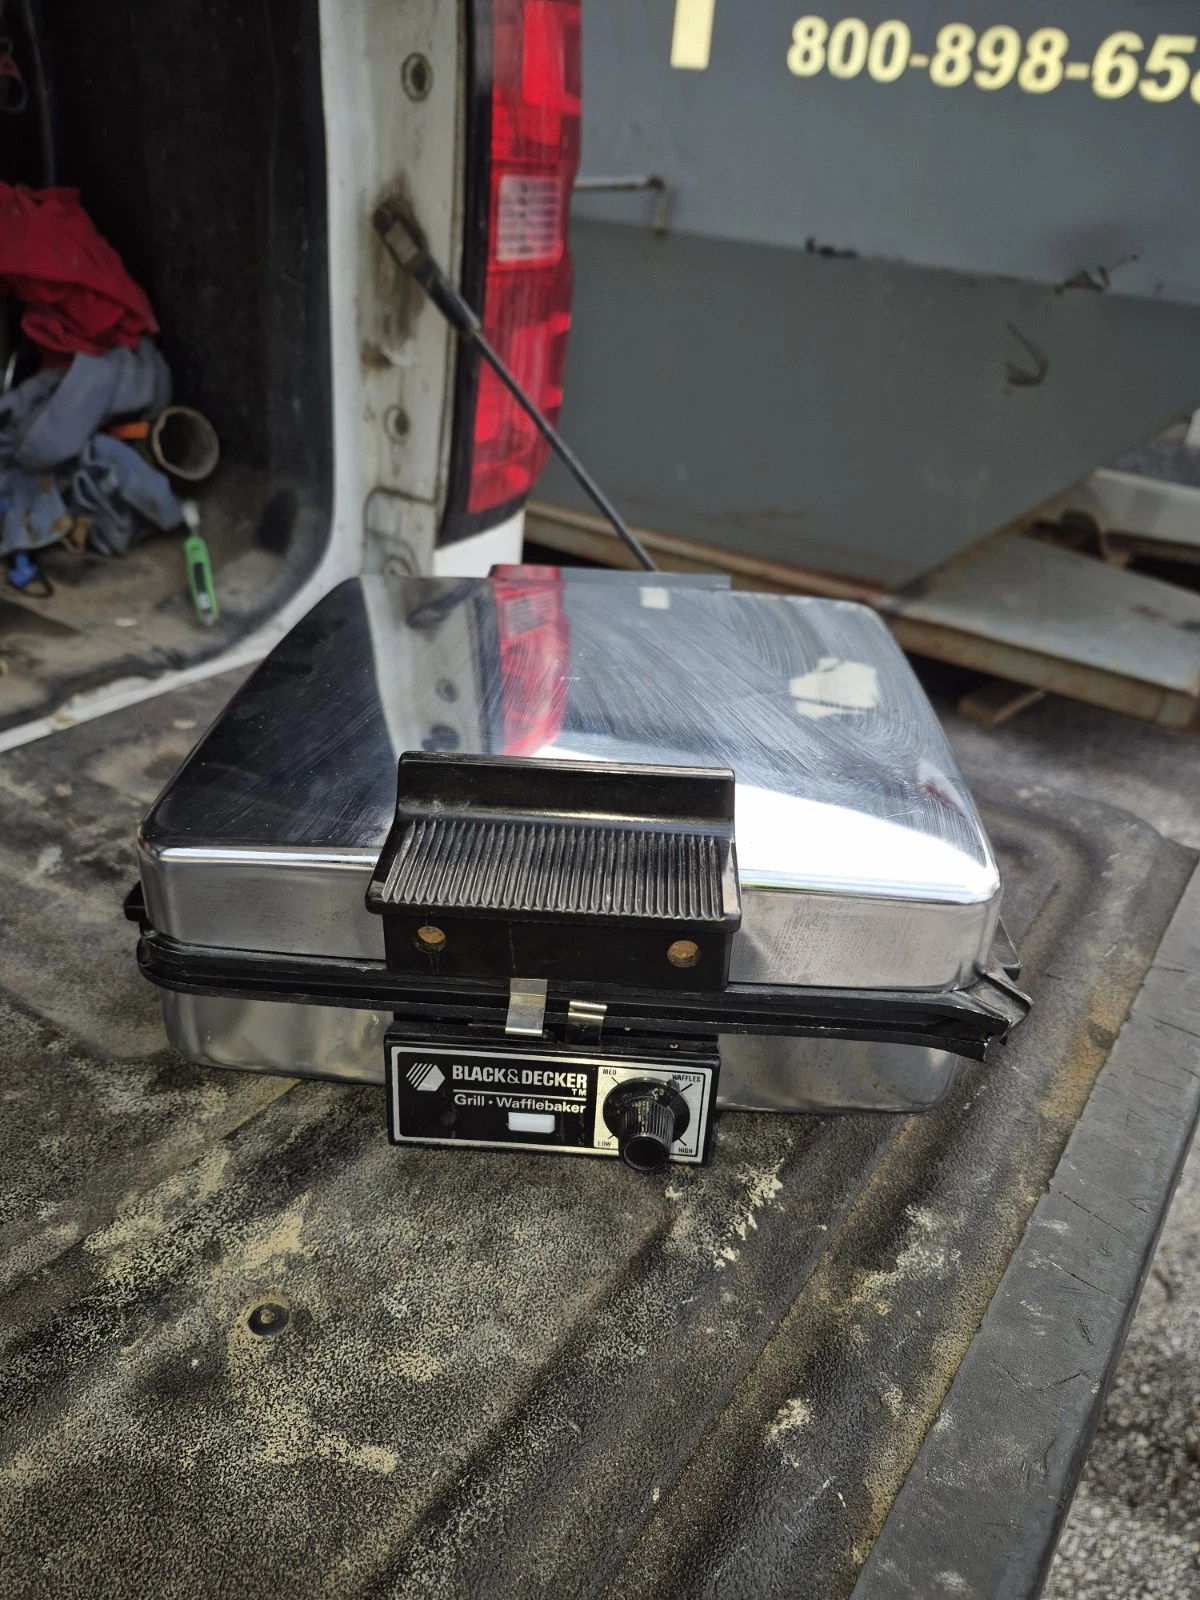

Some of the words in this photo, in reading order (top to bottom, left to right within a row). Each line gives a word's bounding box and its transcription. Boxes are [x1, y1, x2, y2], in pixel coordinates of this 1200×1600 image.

[787, 15, 1200, 104] 800-898-65
[452, 1064, 587, 1089] BLACK&DECKER
[602, 1068, 617, 1076] MED
[672, 1074, 701, 1083] WAFFLES
[571, 1088, 587, 1096] TM
[453, 1094, 485, 1107] Grill
[496, 1097, 587, 1114] Wafflebaker
